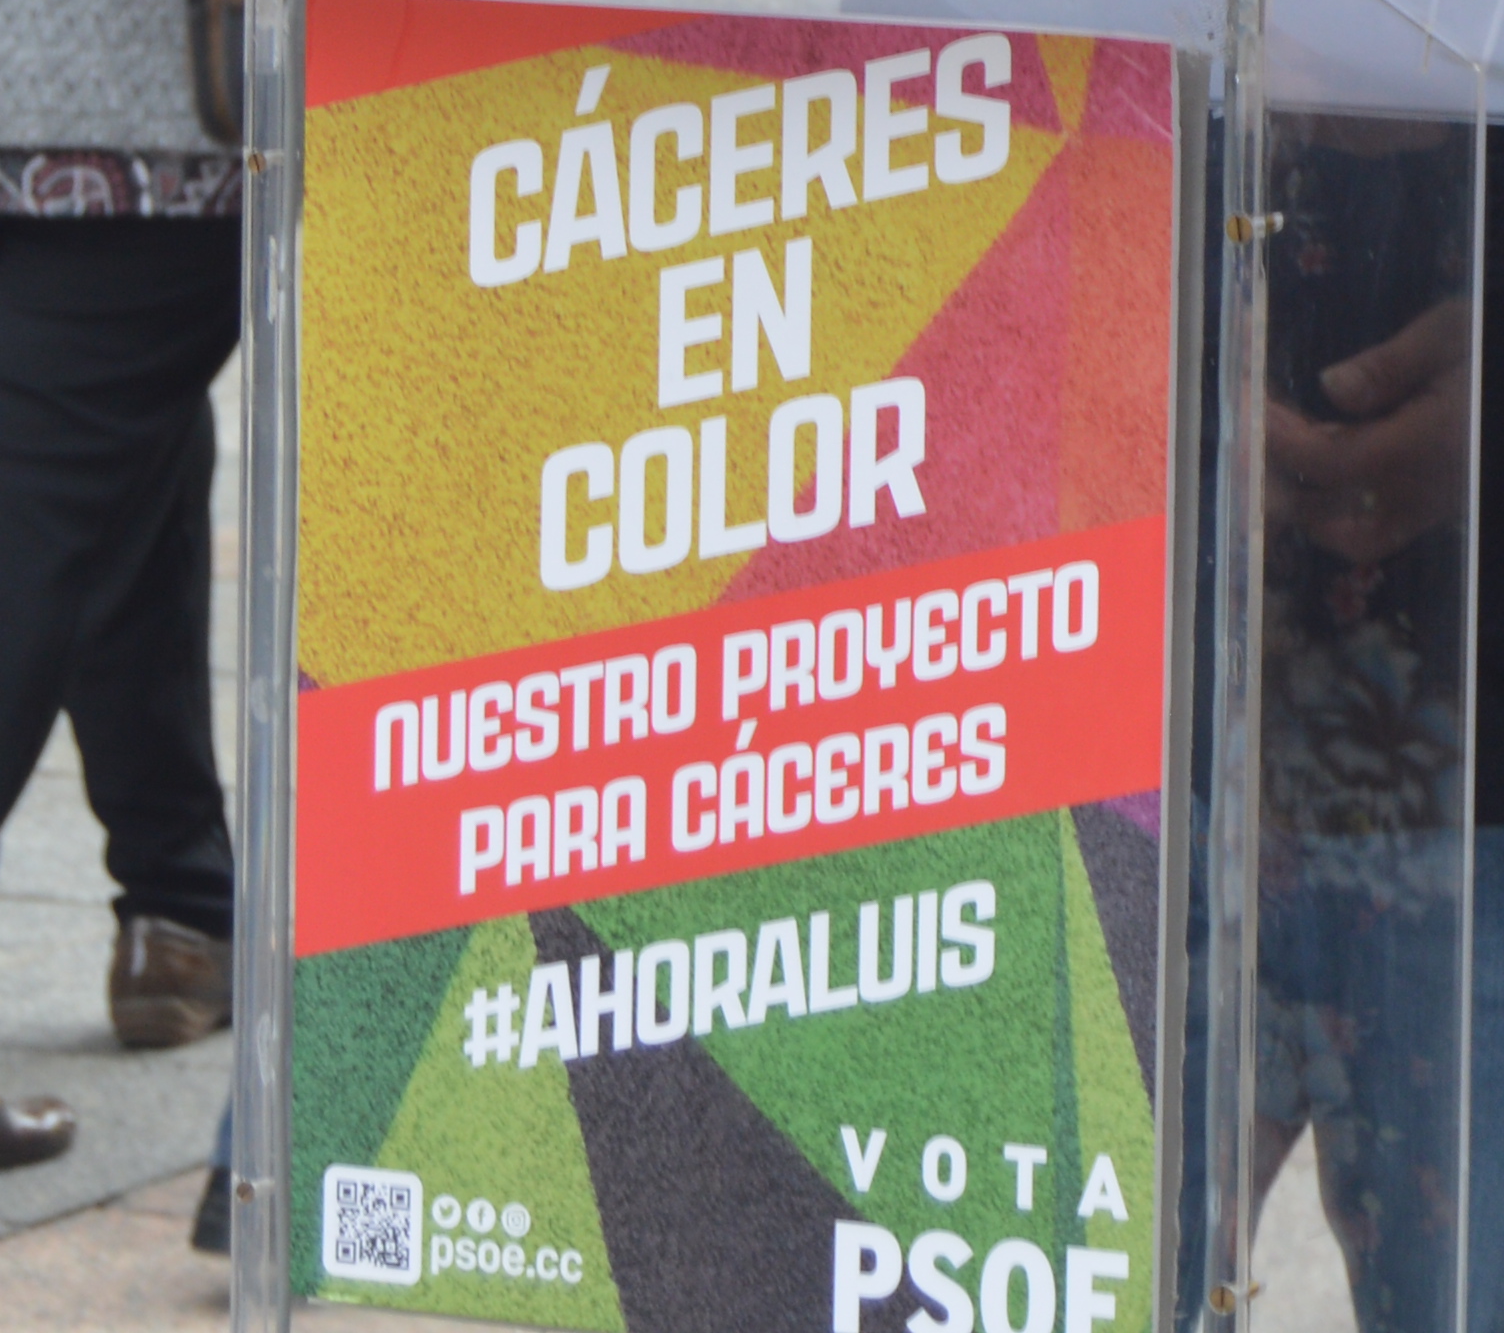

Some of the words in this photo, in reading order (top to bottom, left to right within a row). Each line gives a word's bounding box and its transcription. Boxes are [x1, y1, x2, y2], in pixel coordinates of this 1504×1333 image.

[468, 31, 1012, 288] CÁCERES
[656, 237, 814, 410] EN
[539, 375, 926, 592] COLOR
[373, 642, 697, 793] NUESTRO
[721, 559, 1100, 722] PROYECTO
[458, 774, 648, 896] PARA
[671, 703, 1006, 855] CÁCERES
[462, 879, 996, 1071] #AHORALUIS
[430, 1233, 583, 1284] psoe.cc
[840, 1124, 1130, 1222] VOTA
